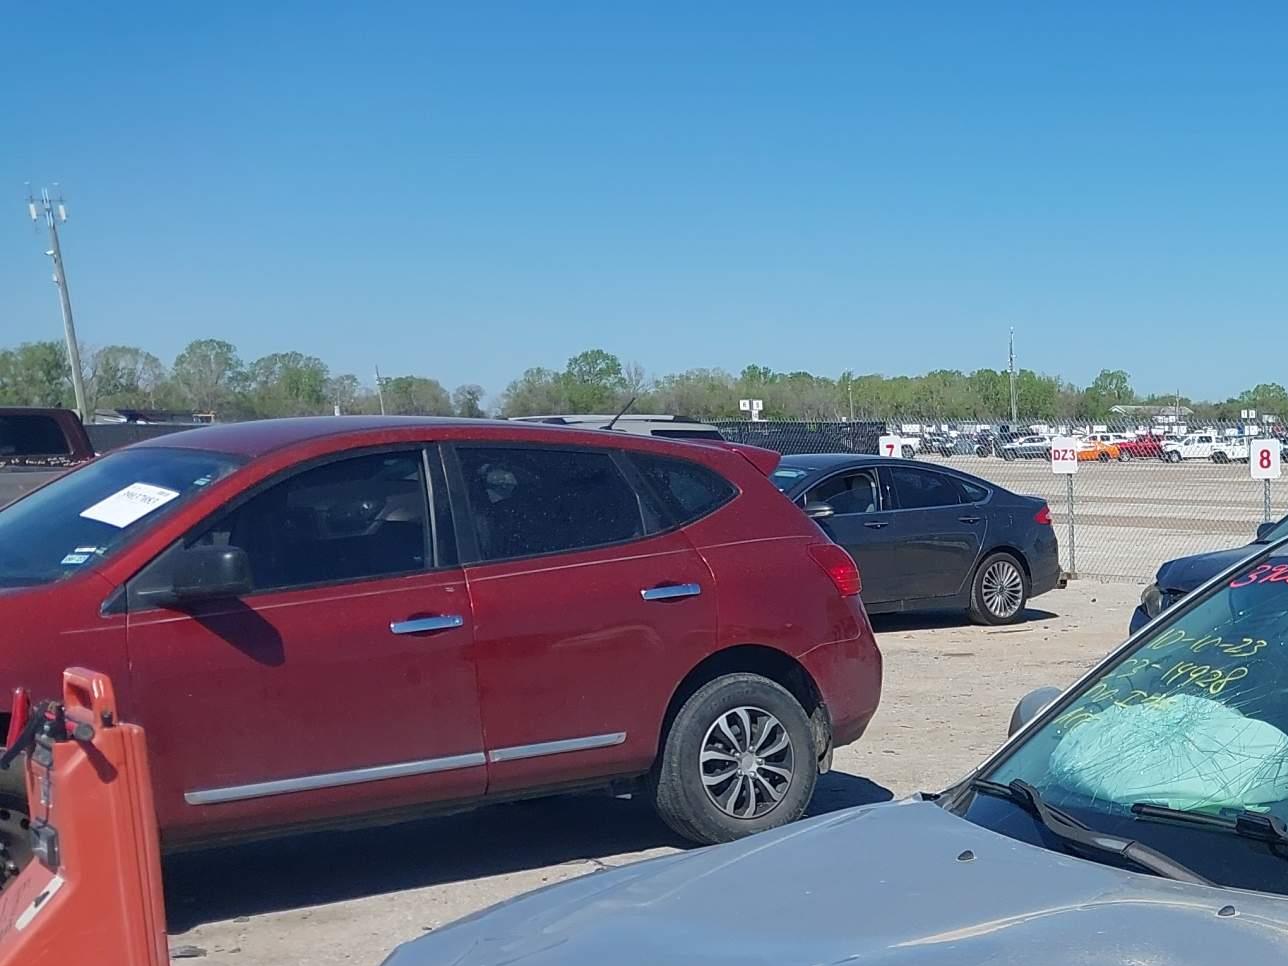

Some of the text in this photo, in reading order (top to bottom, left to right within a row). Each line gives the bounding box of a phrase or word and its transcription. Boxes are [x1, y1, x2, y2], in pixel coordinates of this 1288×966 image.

[885, 444, 895, 457] 7
[1053, 449, 1076, 460] DZ3
[1259, 449, 1271, 469] 8
